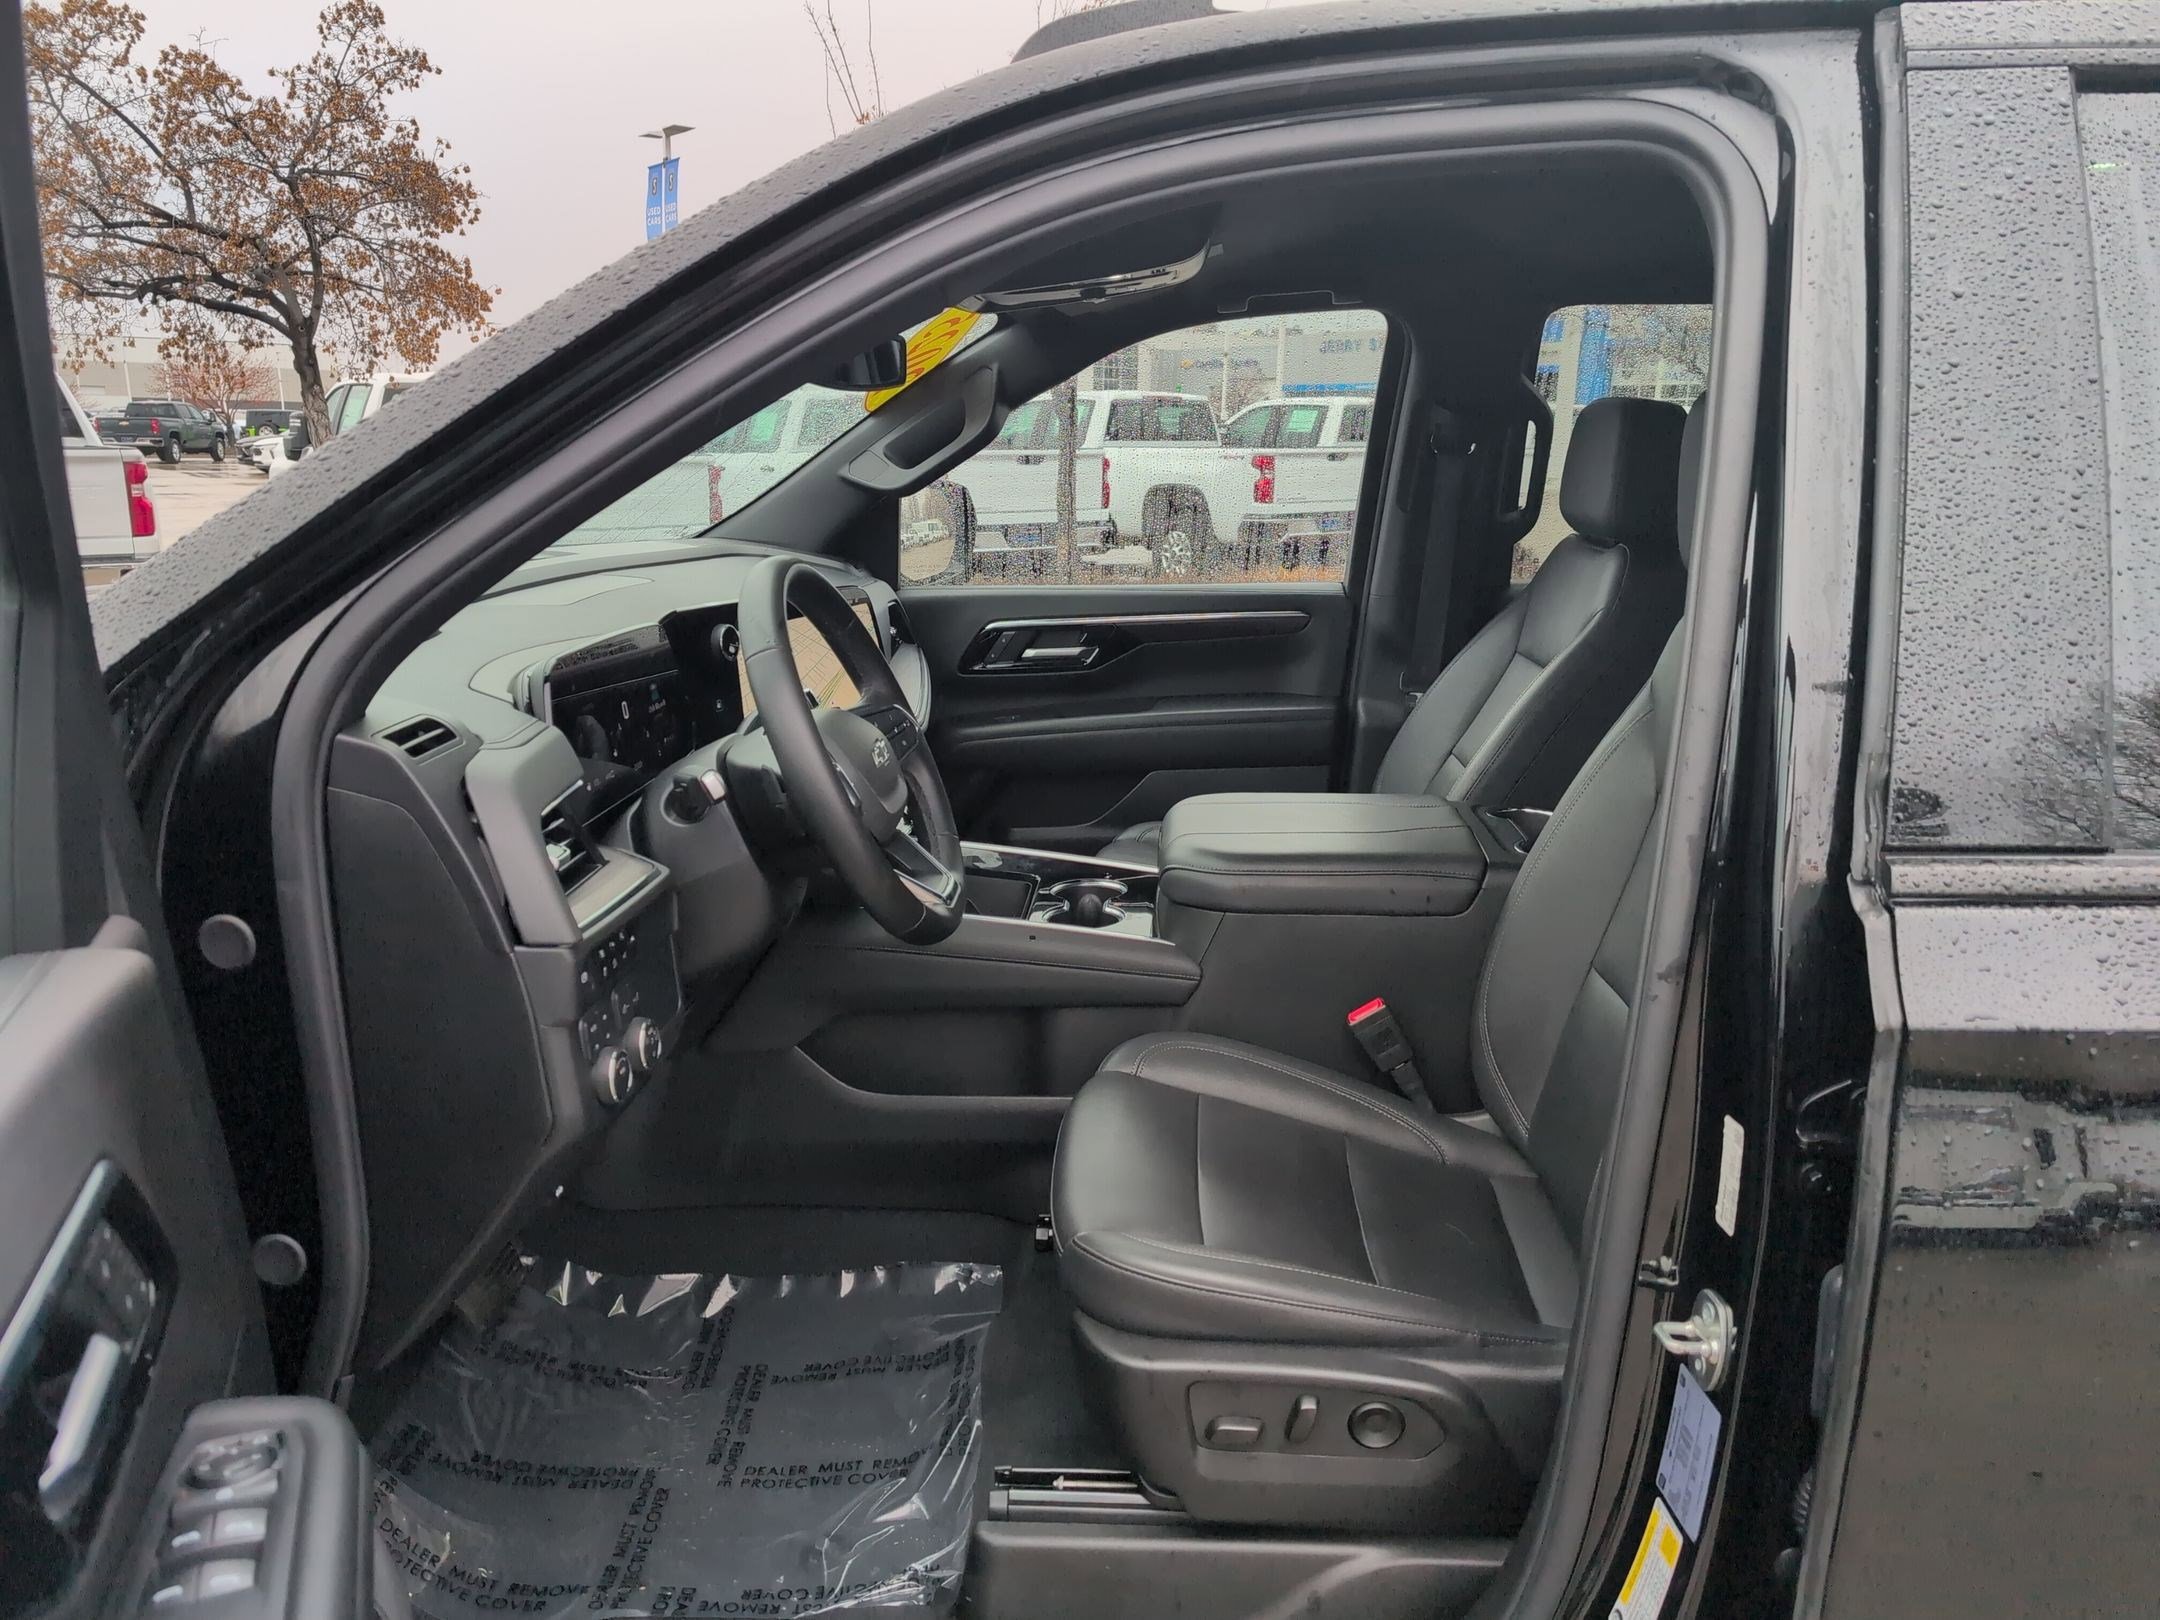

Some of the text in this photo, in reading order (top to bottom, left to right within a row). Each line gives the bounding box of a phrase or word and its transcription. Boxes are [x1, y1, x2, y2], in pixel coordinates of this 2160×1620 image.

[647, 206, 661, 216] USED
[647, 215, 662, 226] CARS
[743, 1463, 808, 1477] DEALER
[817, 1458, 865, 1474] MUST
[740, 1466, 911, 1490] PROTECTIVE COVER
[379, 1517, 590, 1597] DEALER MUST REMOVE
[474, 1594, 547, 1612] COVER
[740, 1587, 811, 1602] COVER
[698, 1600, 781, 1616] REMOVE
